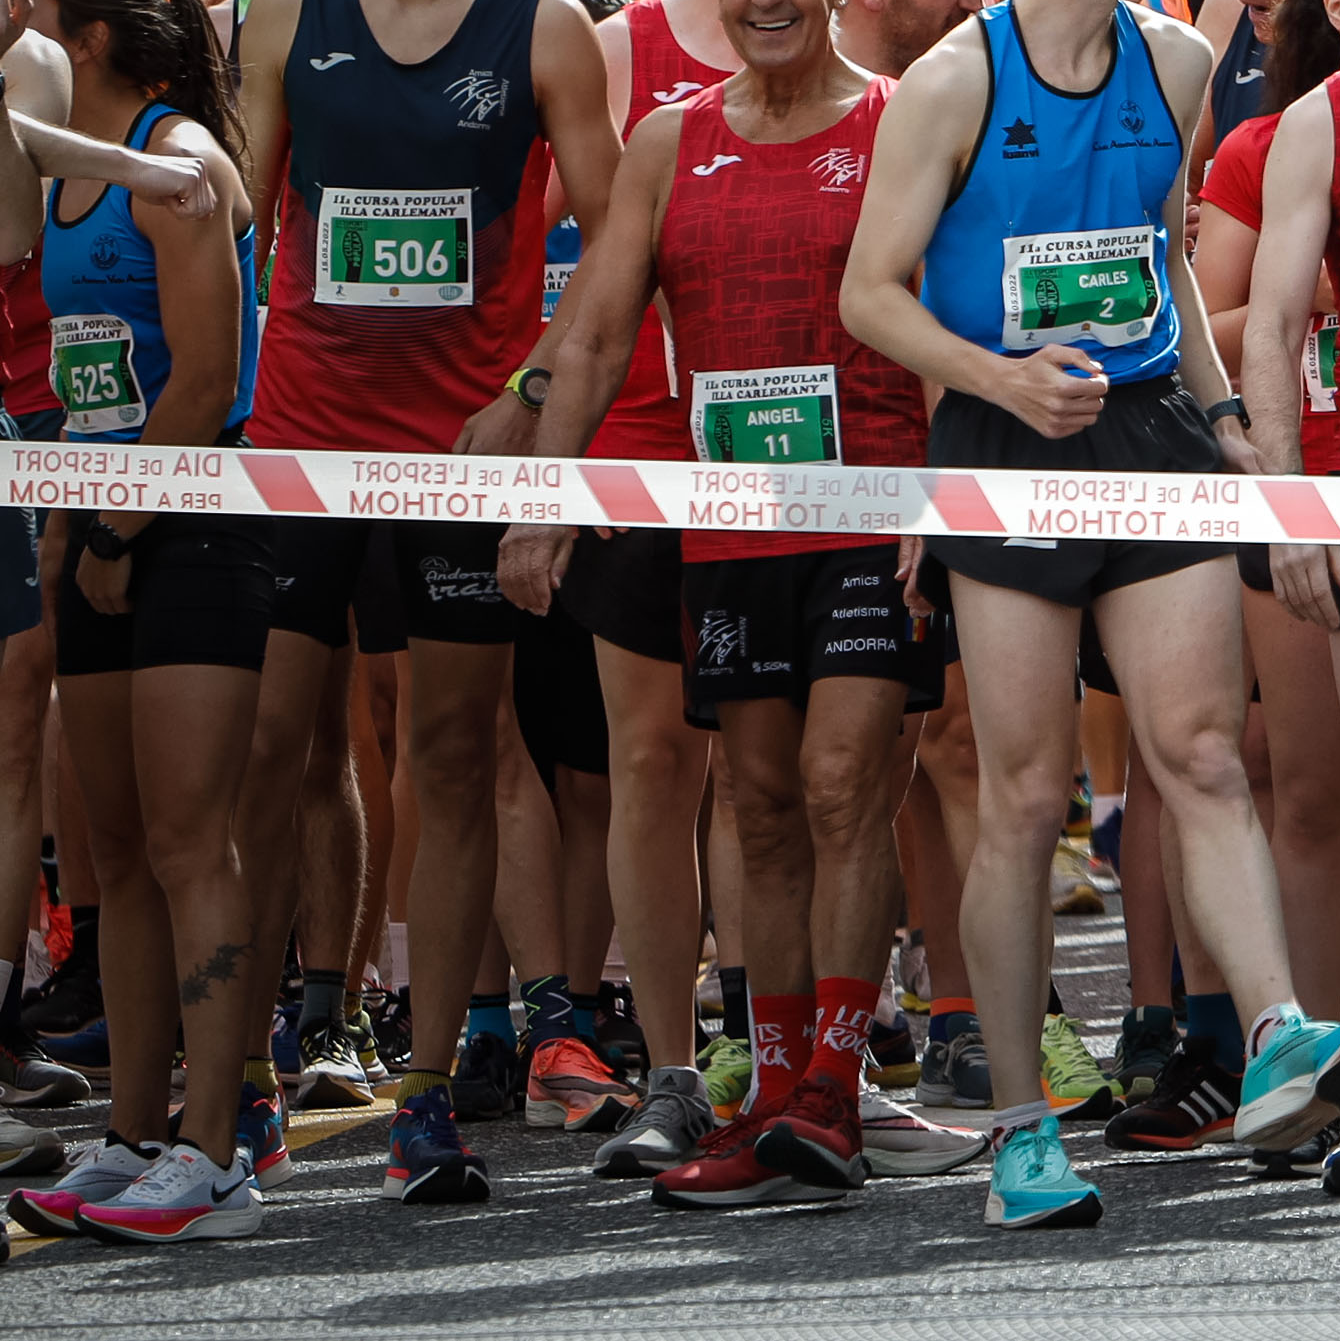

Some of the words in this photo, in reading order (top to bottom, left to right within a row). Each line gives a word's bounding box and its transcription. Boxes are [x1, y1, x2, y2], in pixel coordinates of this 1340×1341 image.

[354, 196, 399, 205] CURSA
[405, 196, 464, 205] POPULAR
[340, 207, 367, 216] ILLA
[373, 207, 457, 216] CARLEMANY
[1046, 240, 1092, 252] CURSA
[1097, 234, 1148, 248] POPULAR
[374, 240, 448, 277] 506
[1030, 254, 1061, 264] ILLA
[1067, 246, 1140, 262] CARLEMANY
[1079, 270, 1128, 288] CARLES
[1099, 297, 1114, 318] 2
[71, 363, 119, 404] 525
[721, 379, 758, 389] CURSA
[764, 373, 828, 385] POPULAR
[712, 392, 732, 400] ILLA
[737, 385, 819, 398] CARLEMANY
[747, 408, 804, 426] ANGEL
[764, 434, 790, 456] 11
[842, 575, 880, 590] Amics
[832, 607, 889, 619] Atletisme
[825, 638, 897, 655] ANDORRA
